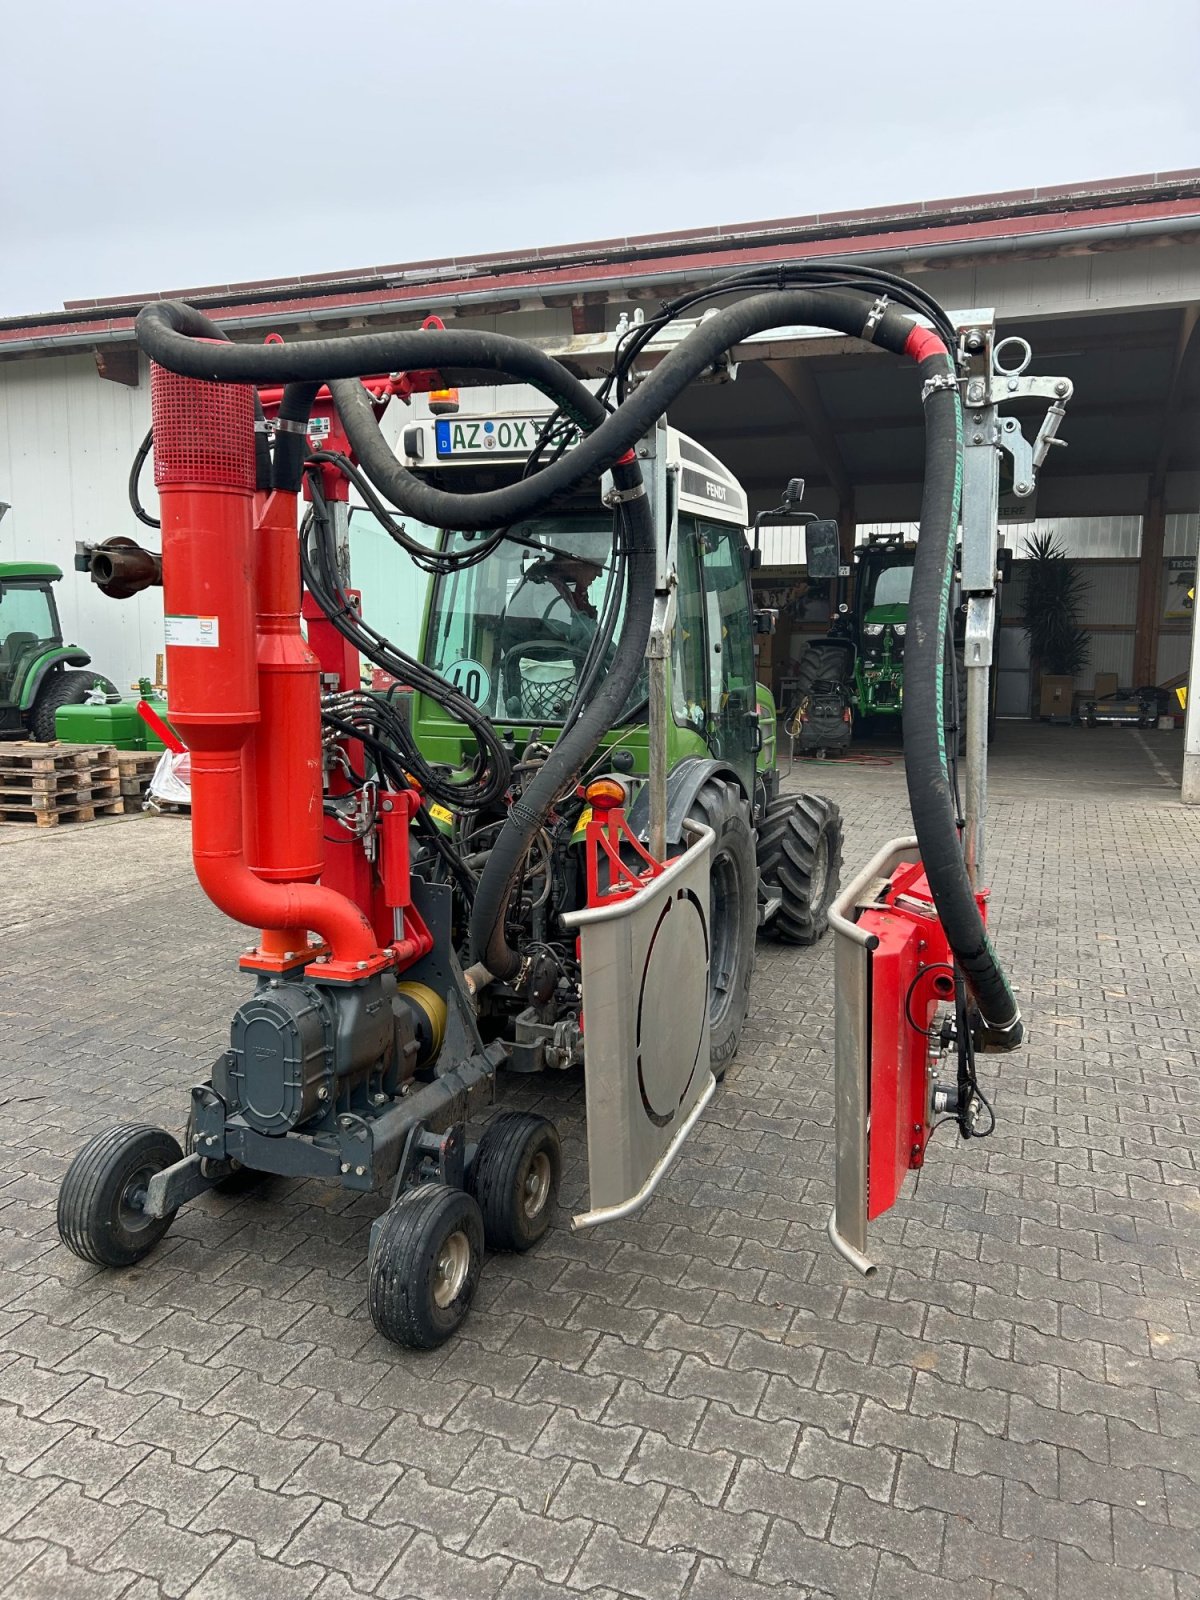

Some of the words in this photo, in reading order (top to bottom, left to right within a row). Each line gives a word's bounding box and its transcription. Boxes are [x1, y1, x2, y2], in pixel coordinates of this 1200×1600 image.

[452, 423, 482, 450] AZ
[497, 421, 528, 448] OX
[953, 392, 964, 445] PURPO
[706, 481, 727, 502] FENDT
[952, 449, 964, 510] GENERAL
[452, 668, 481, 704] 40
